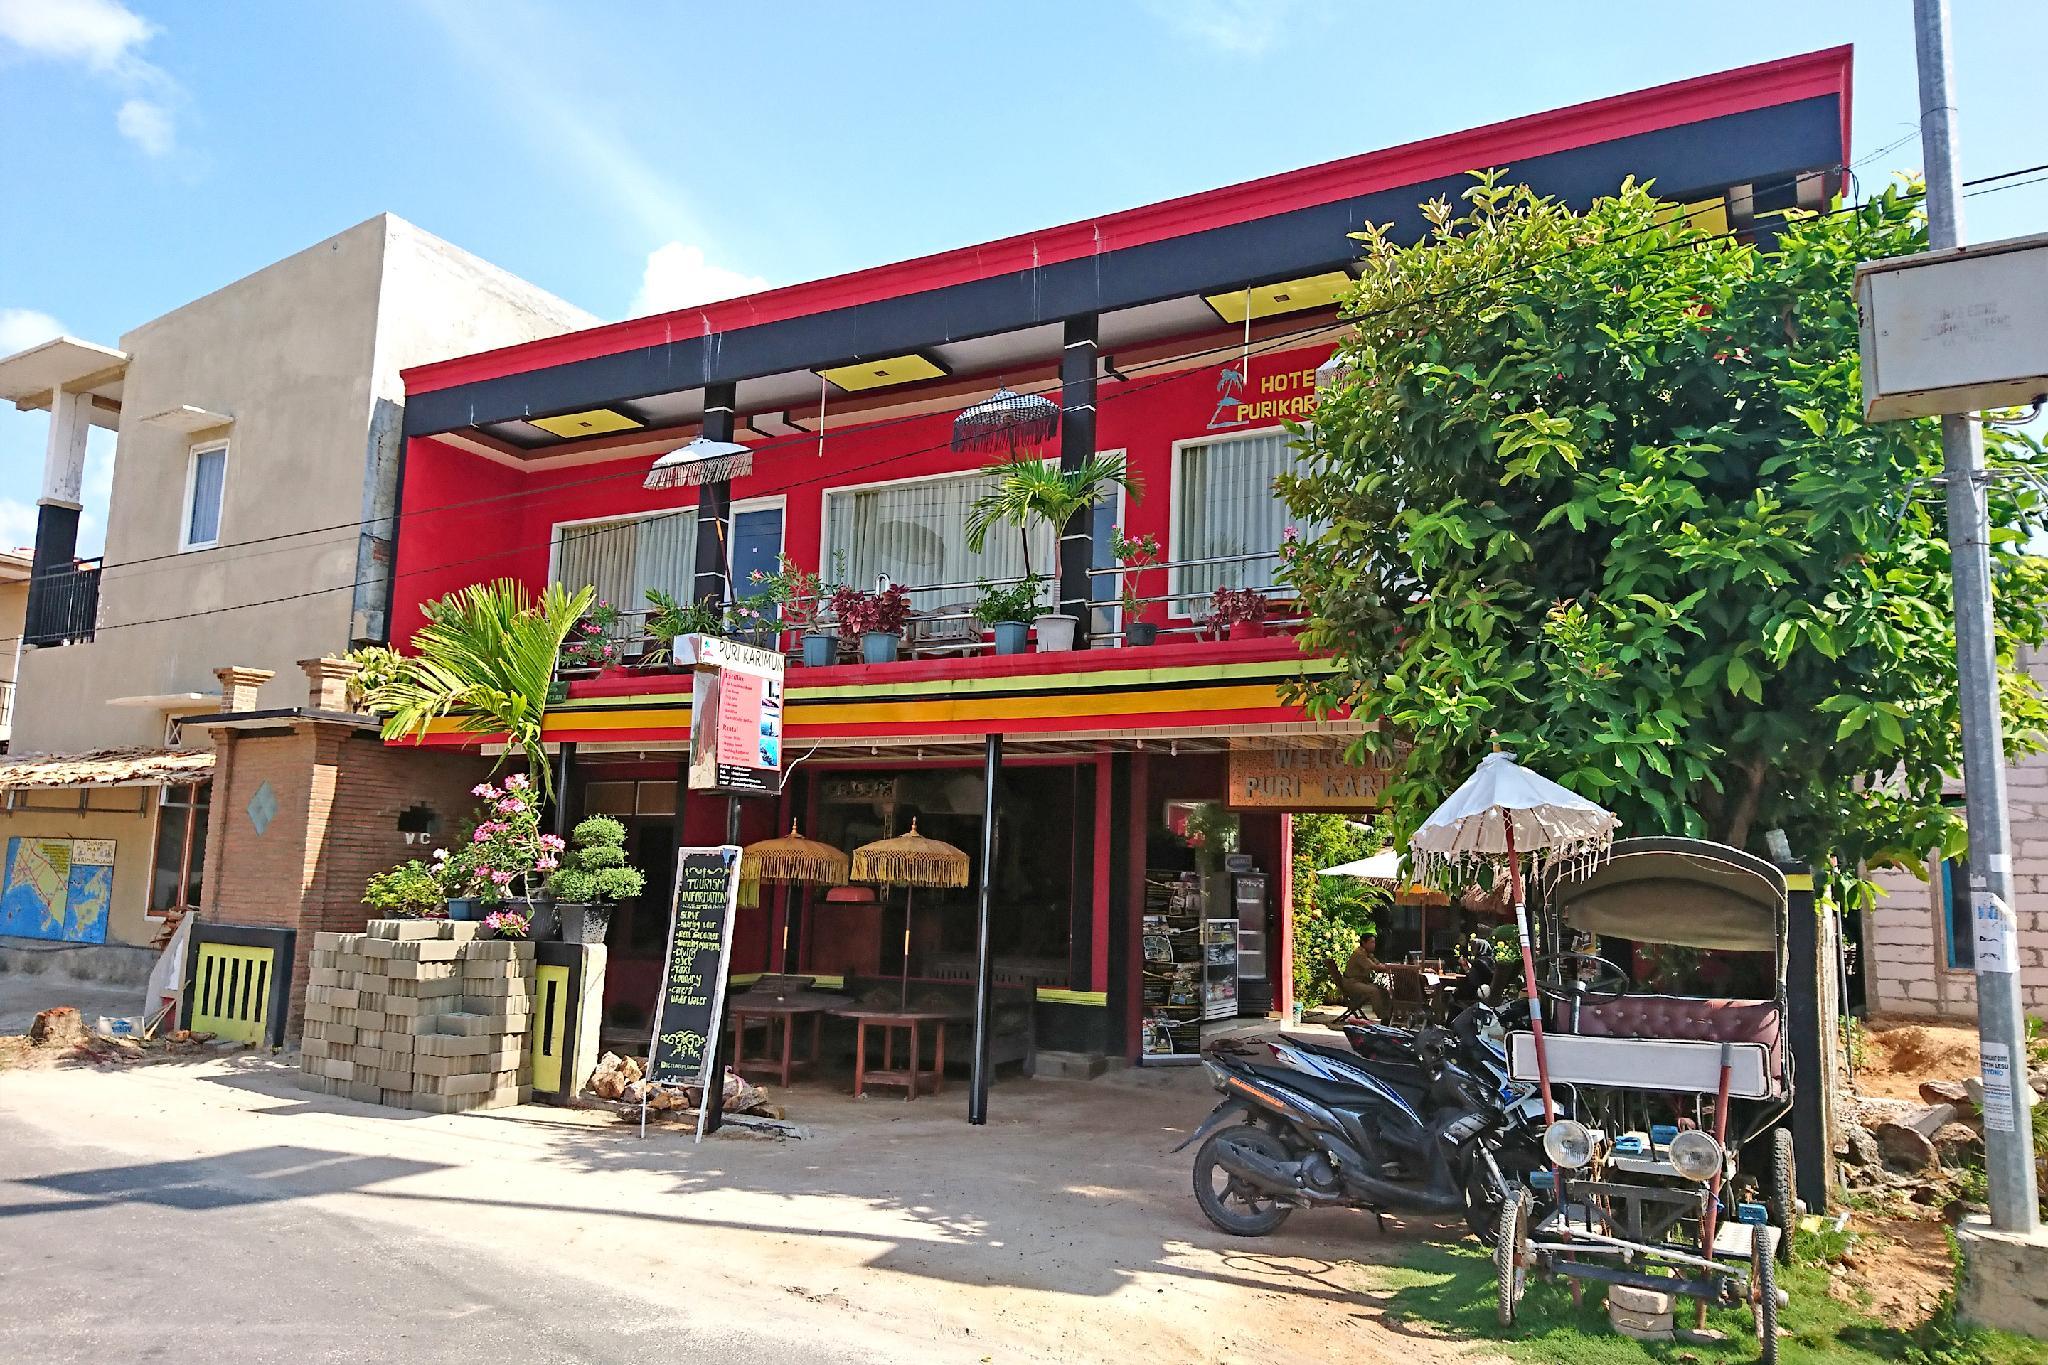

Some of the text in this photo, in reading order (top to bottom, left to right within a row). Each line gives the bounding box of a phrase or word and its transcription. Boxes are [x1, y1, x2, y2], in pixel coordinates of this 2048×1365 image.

[1261, 369, 1315, 394] HOTE
[719, 640, 784, 672] PURI KARIMUN
[1274, 749, 1407, 769] WELCME
[1246, 775, 1396, 798] PURI KARI
[687, 878, 725, 891] TOURISM
[682, 891, 728, 904] INFORMATION
